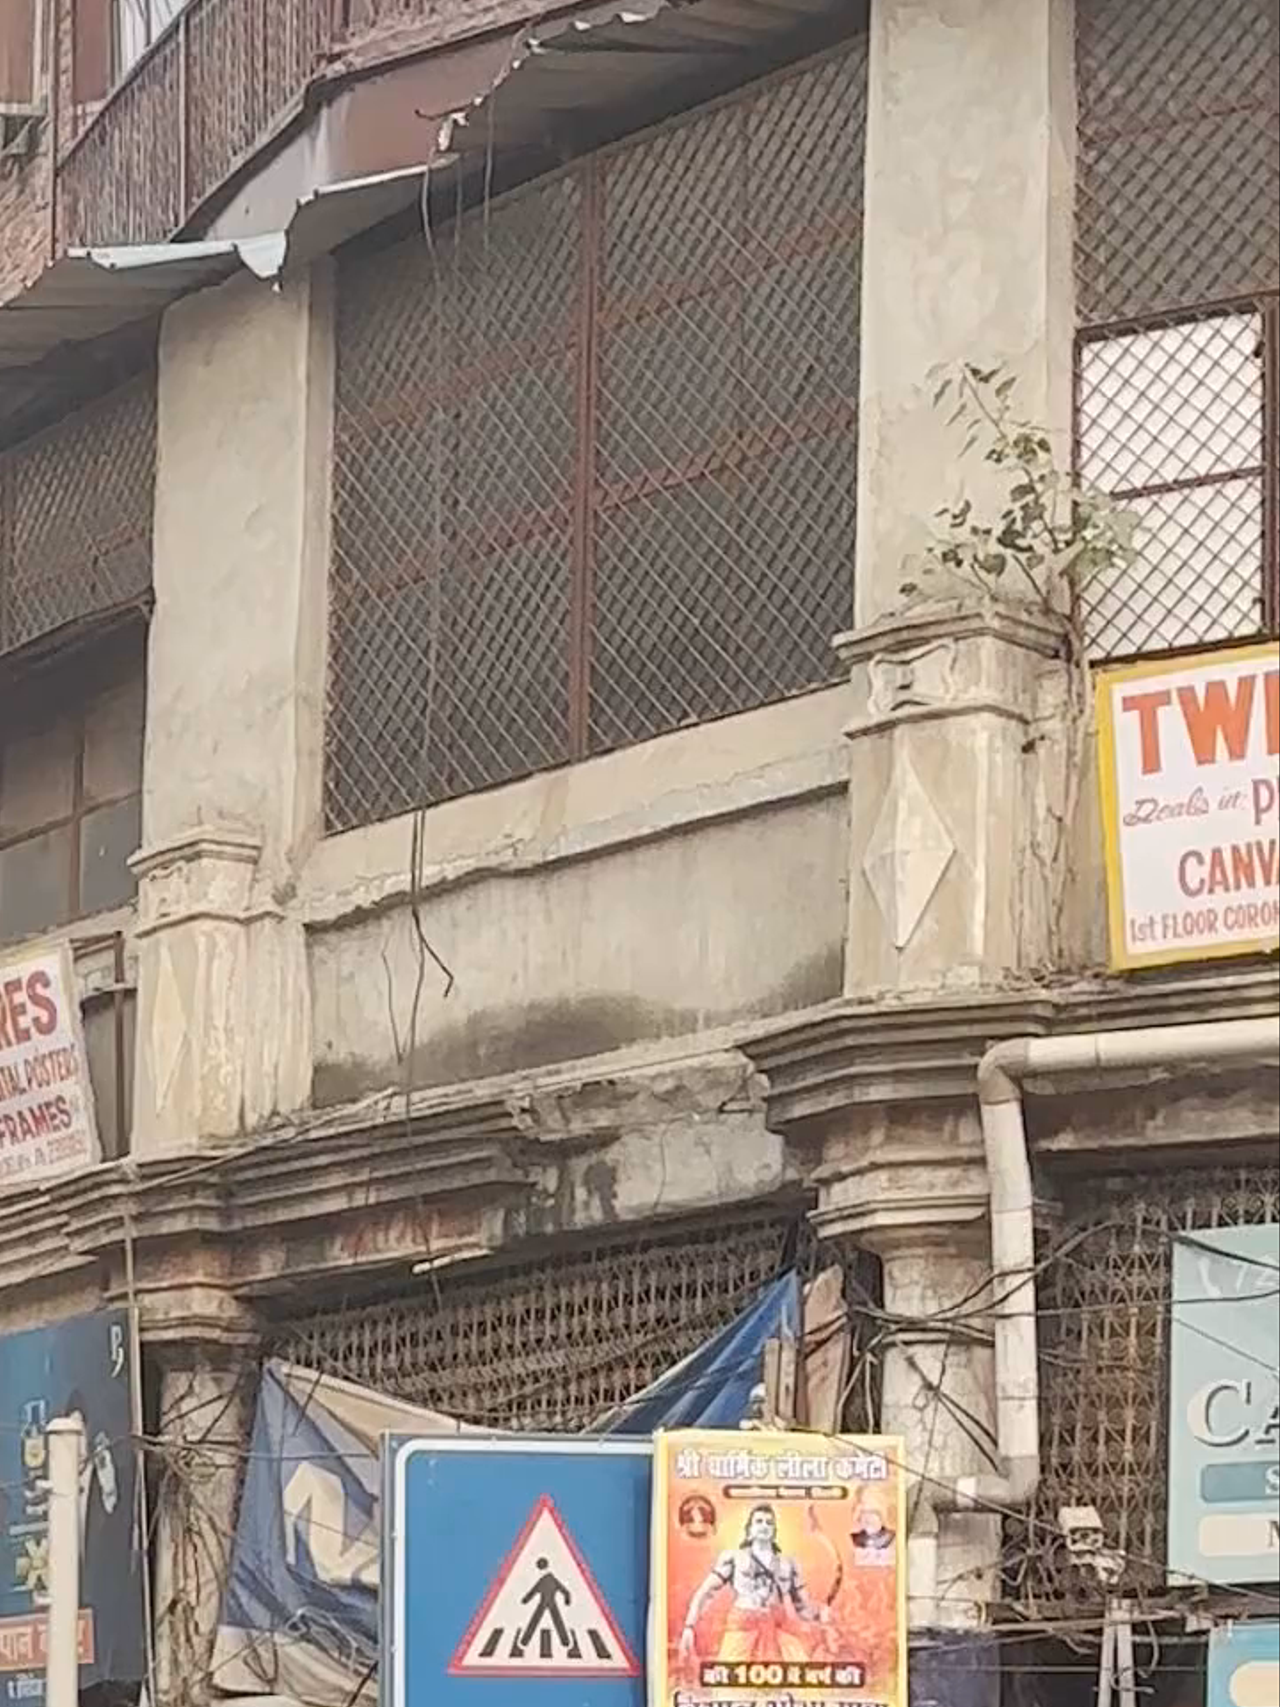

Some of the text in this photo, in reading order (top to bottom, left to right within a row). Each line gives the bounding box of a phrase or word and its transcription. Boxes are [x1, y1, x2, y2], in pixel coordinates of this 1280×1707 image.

[1251, 776, 1280, 826] P
[1178, 838, 1280, 899] CANV
[1161, 908, 1218, 940] FLOOR
[735, 1664, 782, 1684] 100
